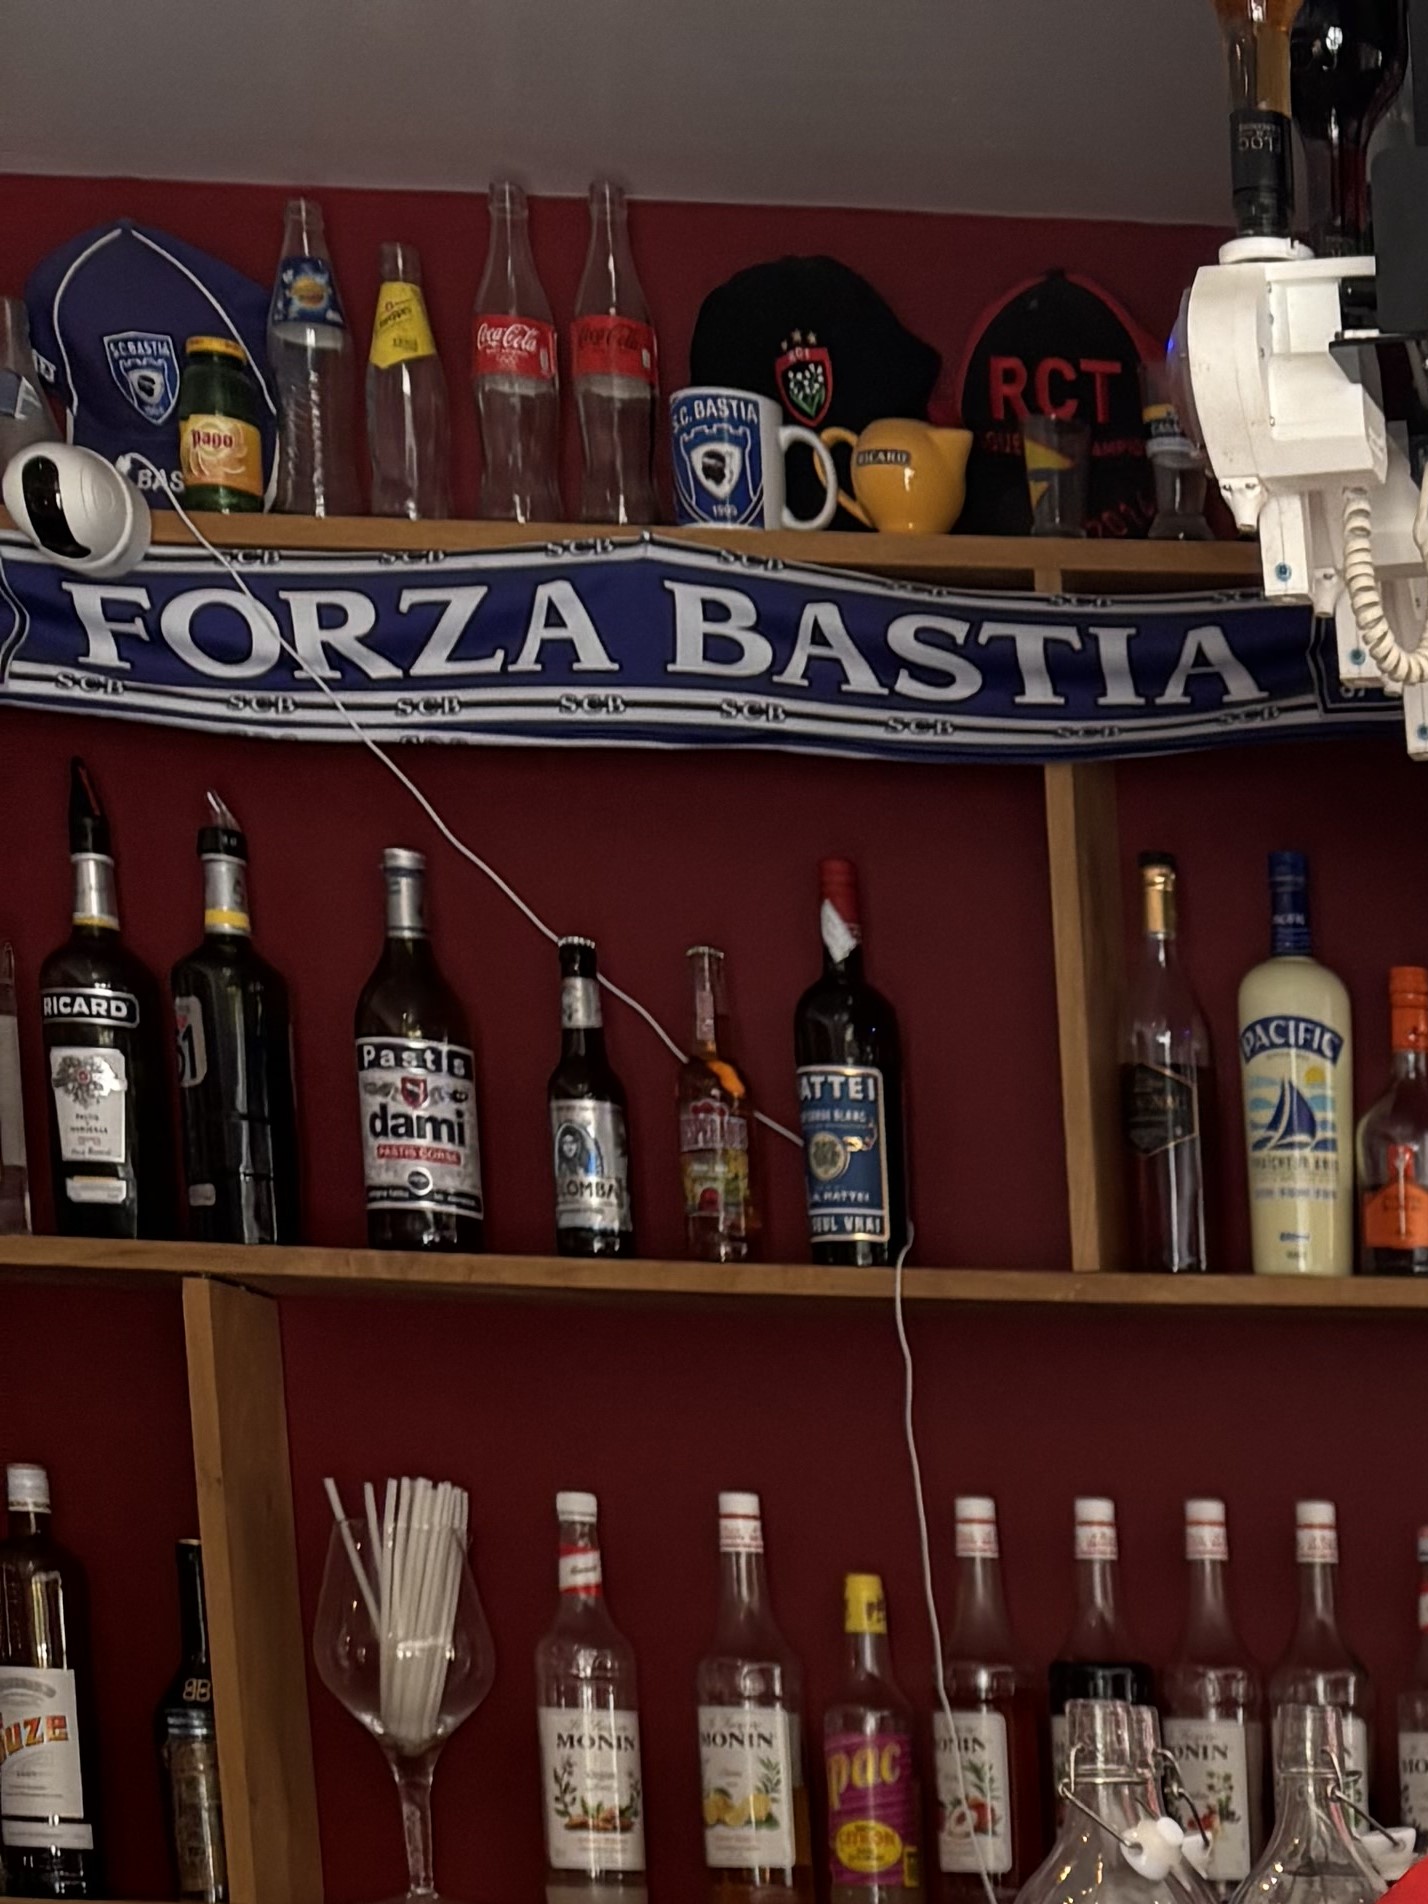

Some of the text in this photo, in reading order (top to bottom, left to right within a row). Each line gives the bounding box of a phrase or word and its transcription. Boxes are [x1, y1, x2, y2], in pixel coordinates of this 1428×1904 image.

[477, 322, 538, 351] Coca-Cola
[988, 355, 1122, 424] RCT
[694, 398, 758, 425] BASTIA
[61, 579, 1270, 707] FORZA BASTIA
[43, 995, 129, 1018] RICARD
[1242, 1018, 1340, 1059] PACIFIC
[369, 1102, 467, 1147] dami
[556, 1732, 637, 1752] MONIN
[828, 1743, 901, 1811] pac
